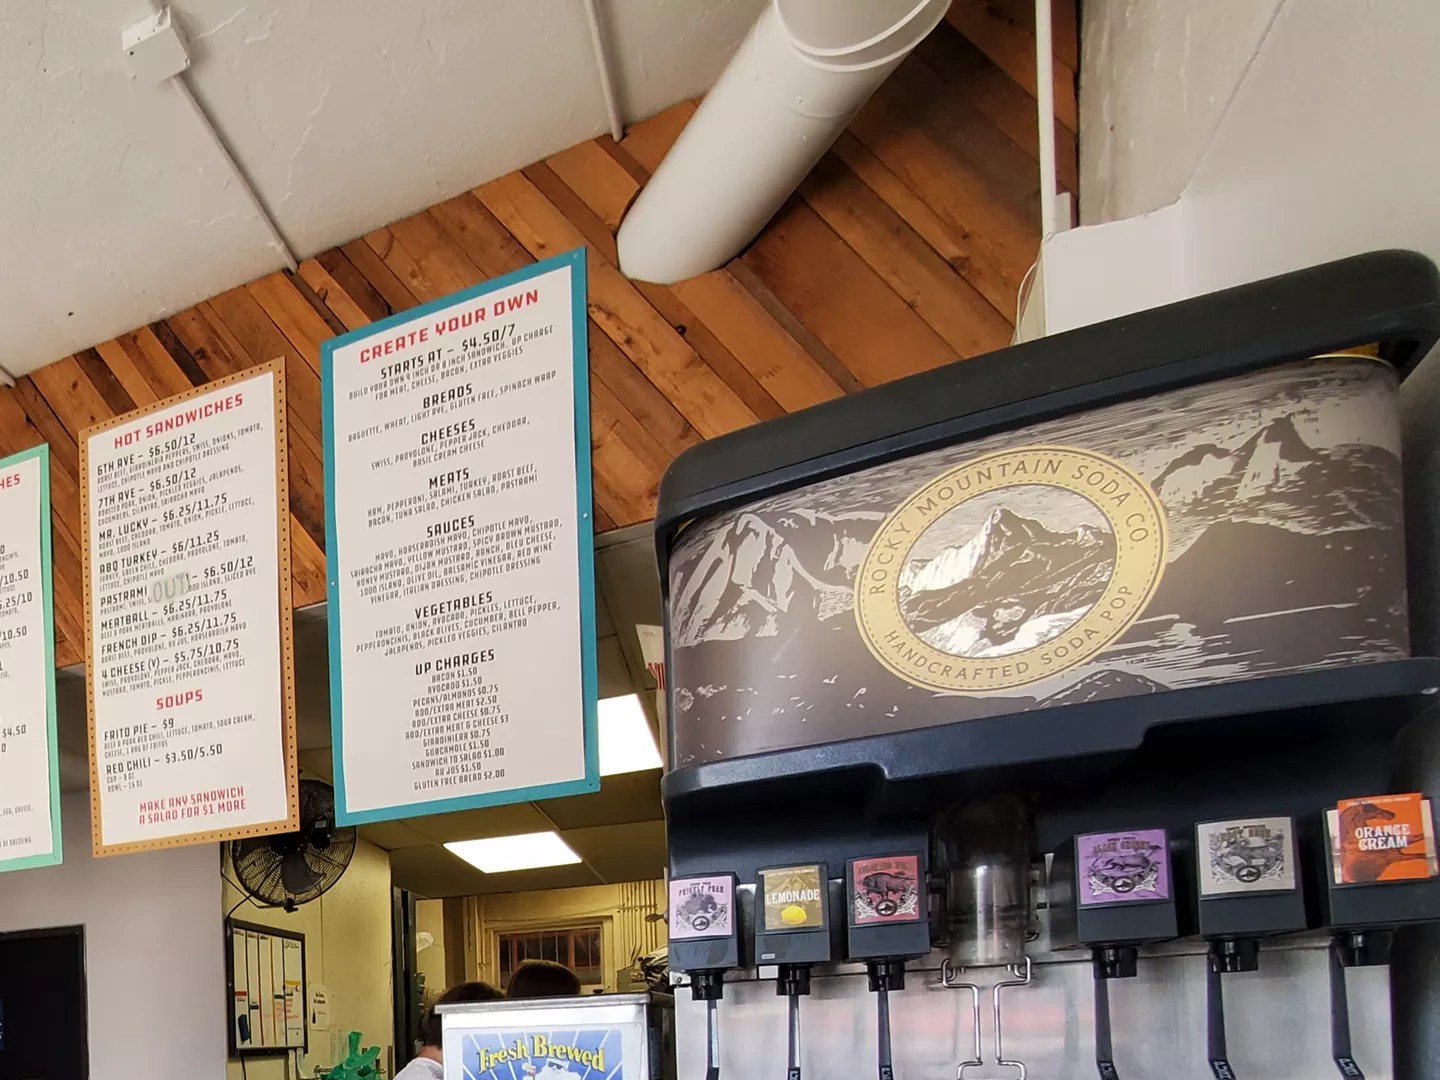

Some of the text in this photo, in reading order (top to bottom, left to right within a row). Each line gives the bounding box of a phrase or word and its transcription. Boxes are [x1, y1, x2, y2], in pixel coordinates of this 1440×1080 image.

[360, 289, 538, 363] CREATE YOUR OWN
[381, 323, 515, 380] STARTS AT $4.50/7
[375, 390, 388, 401] FOR
[470, 356, 491, 370] EXTRA
[493, 345, 523, 362] VEGGIES
[411, 409, 430, 423] LIGHT
[450, 395, 476, 410] GLUTEN
[500, 378, 532, 395] SPINACH
[534, 370, 556, 384] WRAP
[423, 383, 472, 409] BREADS
[114, 393, 243, 449] HOT SANDWICHES
[421, 418, 475, 445] CHEESES
[97, 433, 195, 476] 6TH AVE $6.50/12
[429, 467, 469, 490] MEATS
[395, 508, 413, 520] TUNA
[440, 491, 471, 507] CHICKEN
[501, 474, 537, 491] PASTRAMI
[99, 493, 227, 542] MR. LUCKY $6.25/11.75
[427, 514, 475, 538] SAUCES
[870, 521, 911, 595] ROCKY
[916, 458, 1062, 516] MOUNTAIN
[1072, 464, 1130, 507] SODA
[99, 585, 148, 606] PASTRAMI
[415, 591, 492, 619] VEGETABLES
[101, 589, 227, 631] MEATBALL $6.25/11.75
[102, 612, 236, 655] FRENCH DIP $6.25/11.75
[885, 585, 1133, 680] HANDCRAFTED SODA POP
[415, 649, 494, 675] UP CHARGES
[156, 689, 202, 710] SOUPS
[104, 718, 174, 741] FRITO PIE $9
[106, 743, 222, 775] RED CHILI $3.50/5.50
[412, 756, 448, 770] SANDWICH
[450, 755, 458, 764] TO
[459, 751, 482, 763] SALAD
[414, 779, 439, 790] GLUTEN
[440, 776, 457, 786] FREE
[458, 772, 482, 784] BREAD
[139, 798, 245, 825] A SALAD FOR $1 MORE
[140, 786, 244, 813] MAKE ANY SANDWICH
[1355, 824, 1410, 839] ORANGE
[1358, 836, 1408, 851] CREAM
[766, 888, 820, 906] LEMONADE
[478, 1035, 605, 1074] Fresh Brewed
